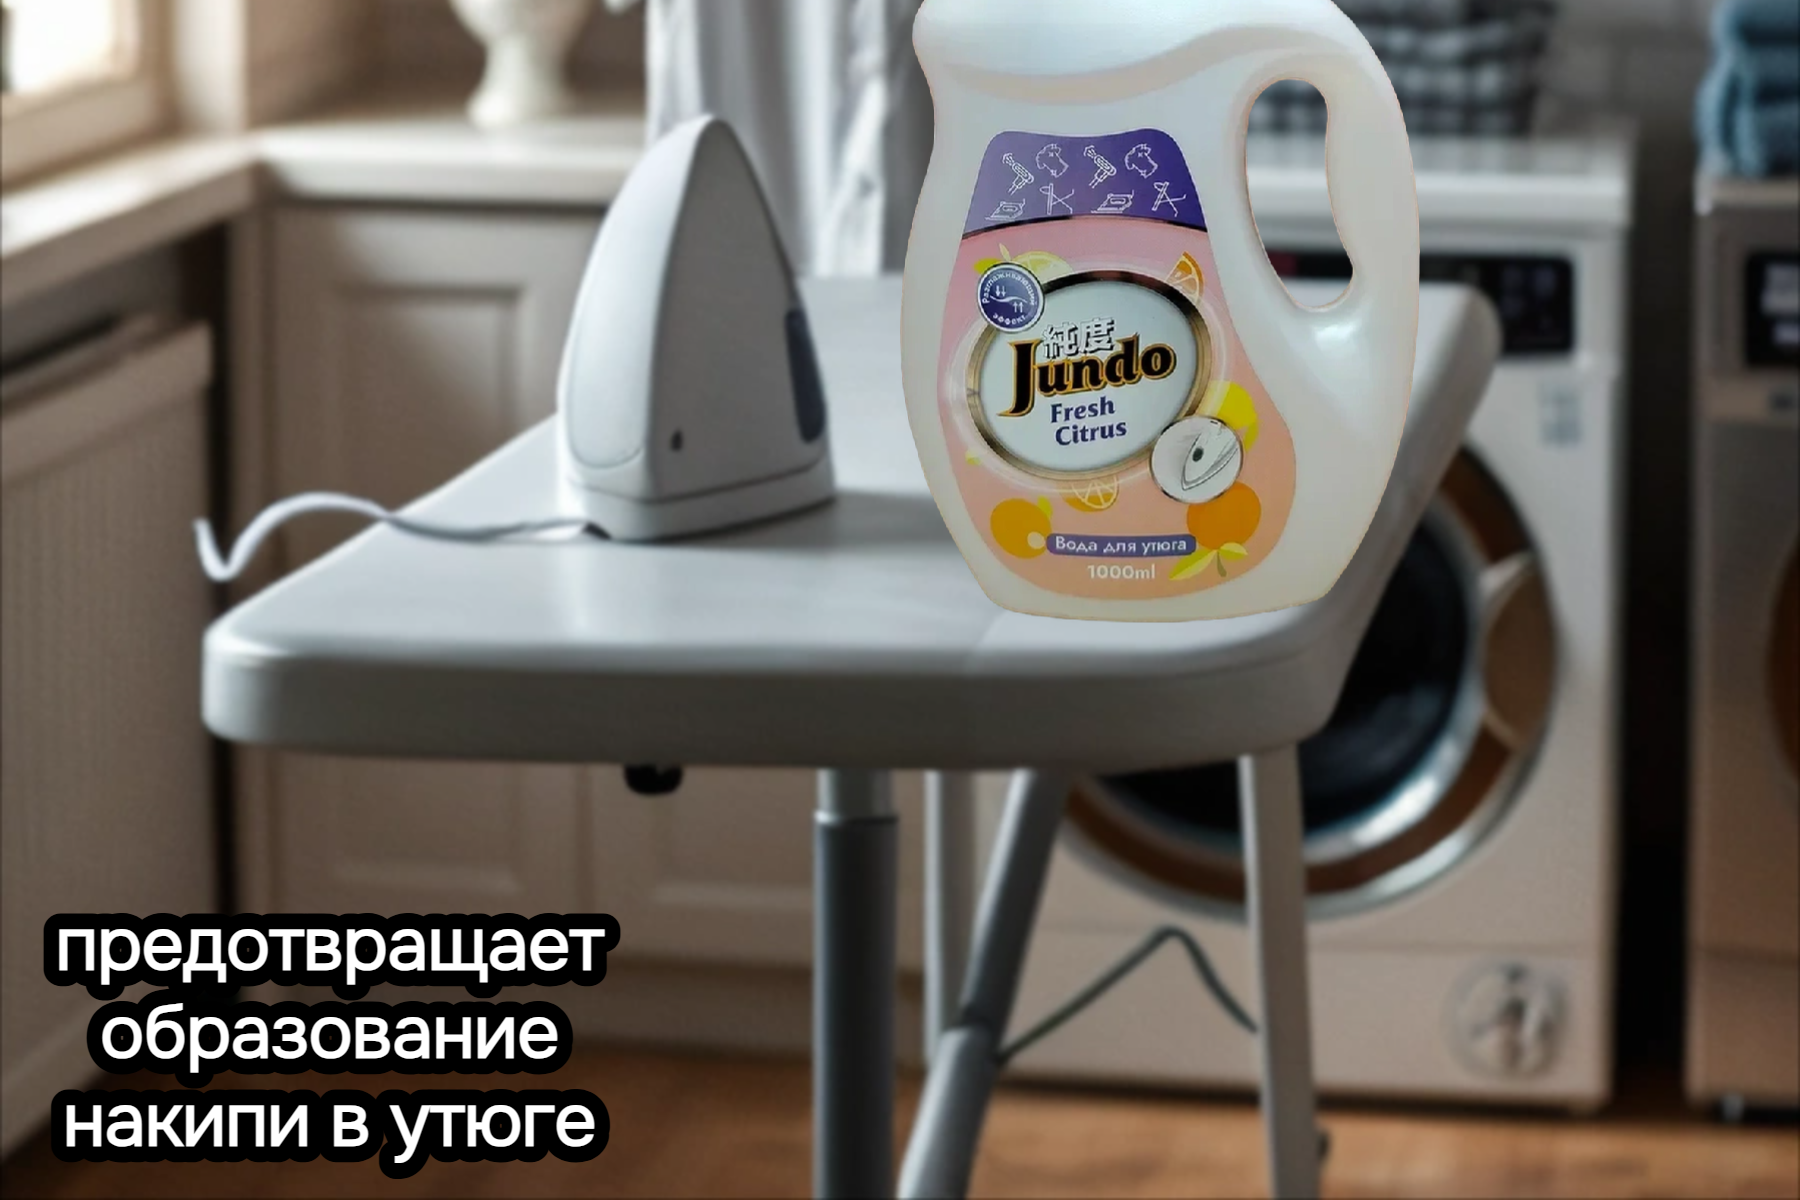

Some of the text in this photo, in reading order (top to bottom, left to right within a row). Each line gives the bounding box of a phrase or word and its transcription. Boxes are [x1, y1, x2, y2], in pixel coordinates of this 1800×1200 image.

[1042, 317, 1115, 359] 純度
[997, 331, 1177, 417] Jundo
[1050, 395, 1116, 424] Fresh
[1055, 420, 1128, 447] Citrus
[1055, 535, 1187, 557] Вода для утюга
[1086, 563, 1156, 580] 1000ml
